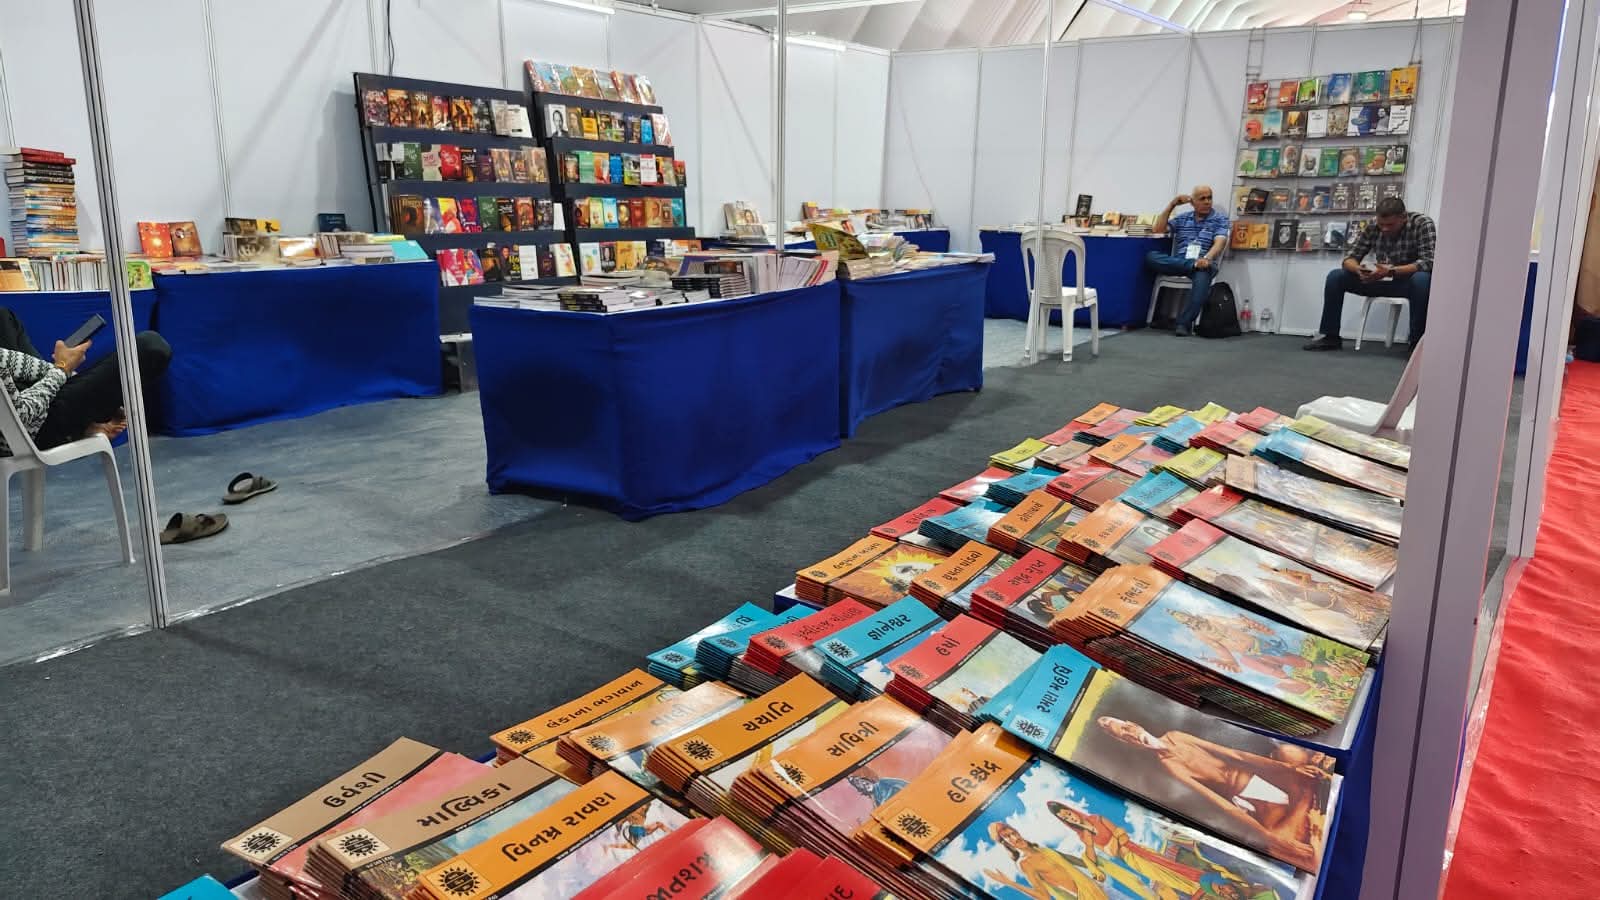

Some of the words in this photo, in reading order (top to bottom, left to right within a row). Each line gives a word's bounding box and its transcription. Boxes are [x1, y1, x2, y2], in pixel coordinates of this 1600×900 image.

[867, 614, 911, 641] જ્ઞાનેશ્વર
[545, 704, 592, 729] લંકાના
[593, 679, 642, 708] ભગવાન
[1036, 688, 1059, 714] રમણ
[1052, 662, 1074, 695] મહર્ષિ
[743, 701, 794, 733] યયાતિ
[826, 720, 879, 757] સાવિત્રી
[322, 772, 386, 809] ઉર્વશી
[416, 782, 511, 829] માલ્વિકા
[502, 824, 562, 862] વિનમ્ર
[562, 792, 616, 827] રાવણ
